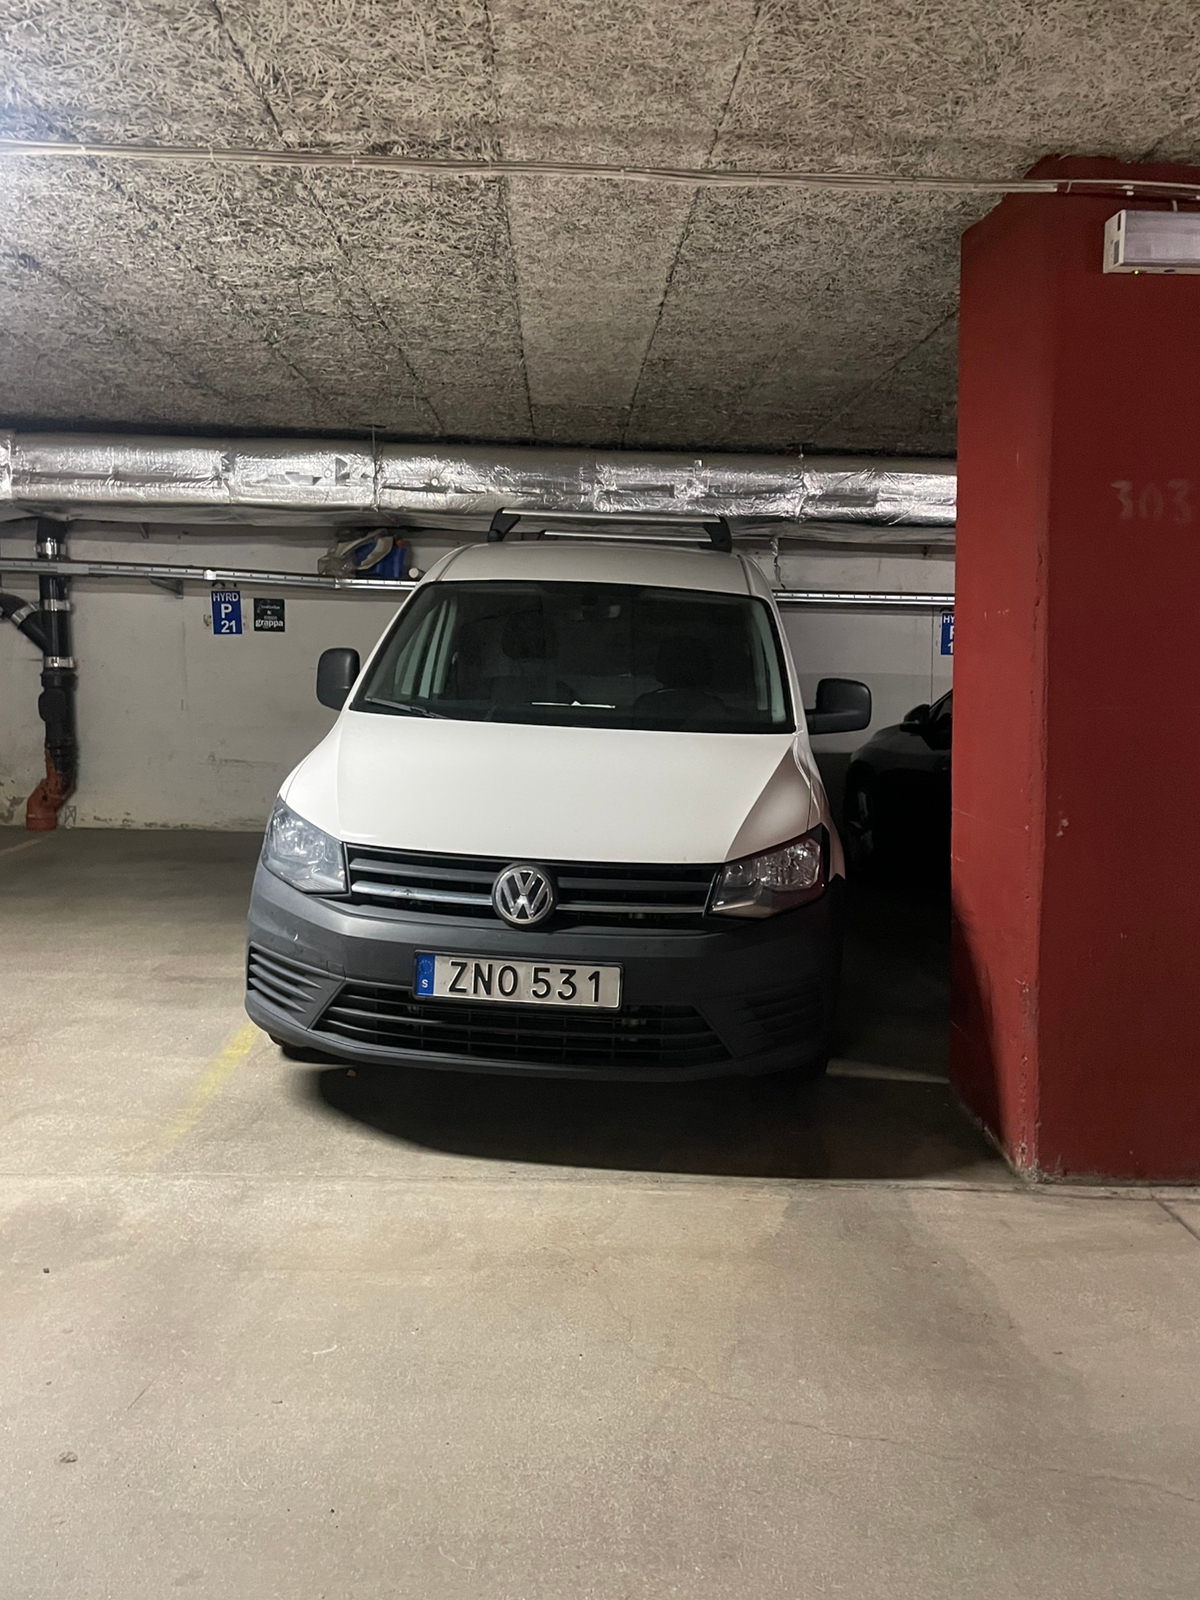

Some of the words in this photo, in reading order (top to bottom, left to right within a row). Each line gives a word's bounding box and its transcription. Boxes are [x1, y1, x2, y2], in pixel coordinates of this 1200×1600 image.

[212, 592, 239, 602] HYRD
[220, 603, 232, 619] P
[255, 619, 284, 628] grappa
[943, 615, 955, 624] HY
[221, 620, 236, 633] 21
[947, 641, 954, 654] 1
[421, 978, 429, 988] S
[448, 961, 519, 997] ZNO
[531, 966, 601, 1002] 531
